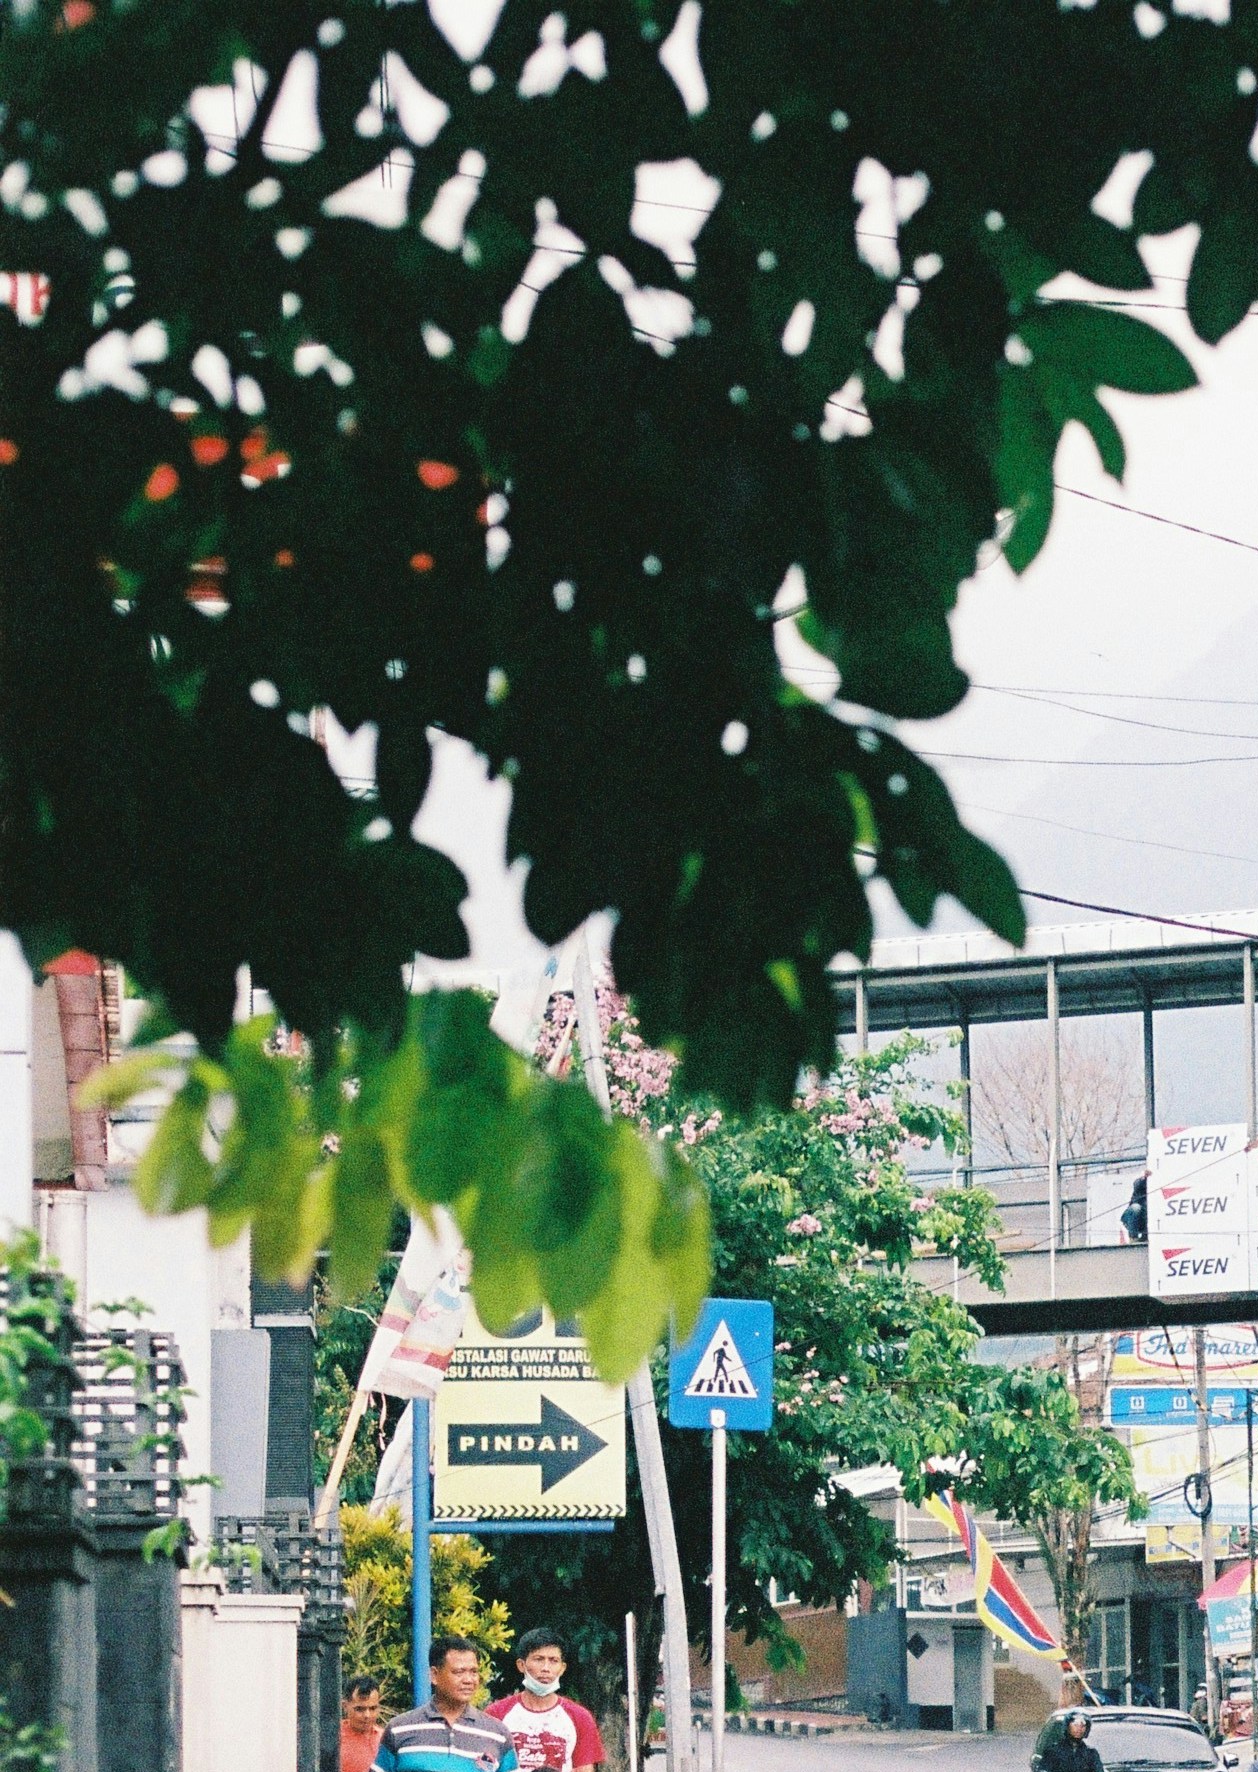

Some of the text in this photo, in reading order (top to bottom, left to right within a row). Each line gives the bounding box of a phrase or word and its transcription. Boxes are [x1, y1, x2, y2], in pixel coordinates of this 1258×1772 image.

[1164, 1136, 1227, 1155] SEVEN
[1165, 1196, 1228, 1216] SEVEN
[1167, 1257, 1229, 1277] SEVEN
[511, 1349, 554, 1363] GAWAT
[558, 1349, 592, 1363] DARU
[471, 1366, 519, 1378] KARSA
[523, 1366, 579, 1378] HUSADA
[459, 1435, 579, 1451] PINDAH
